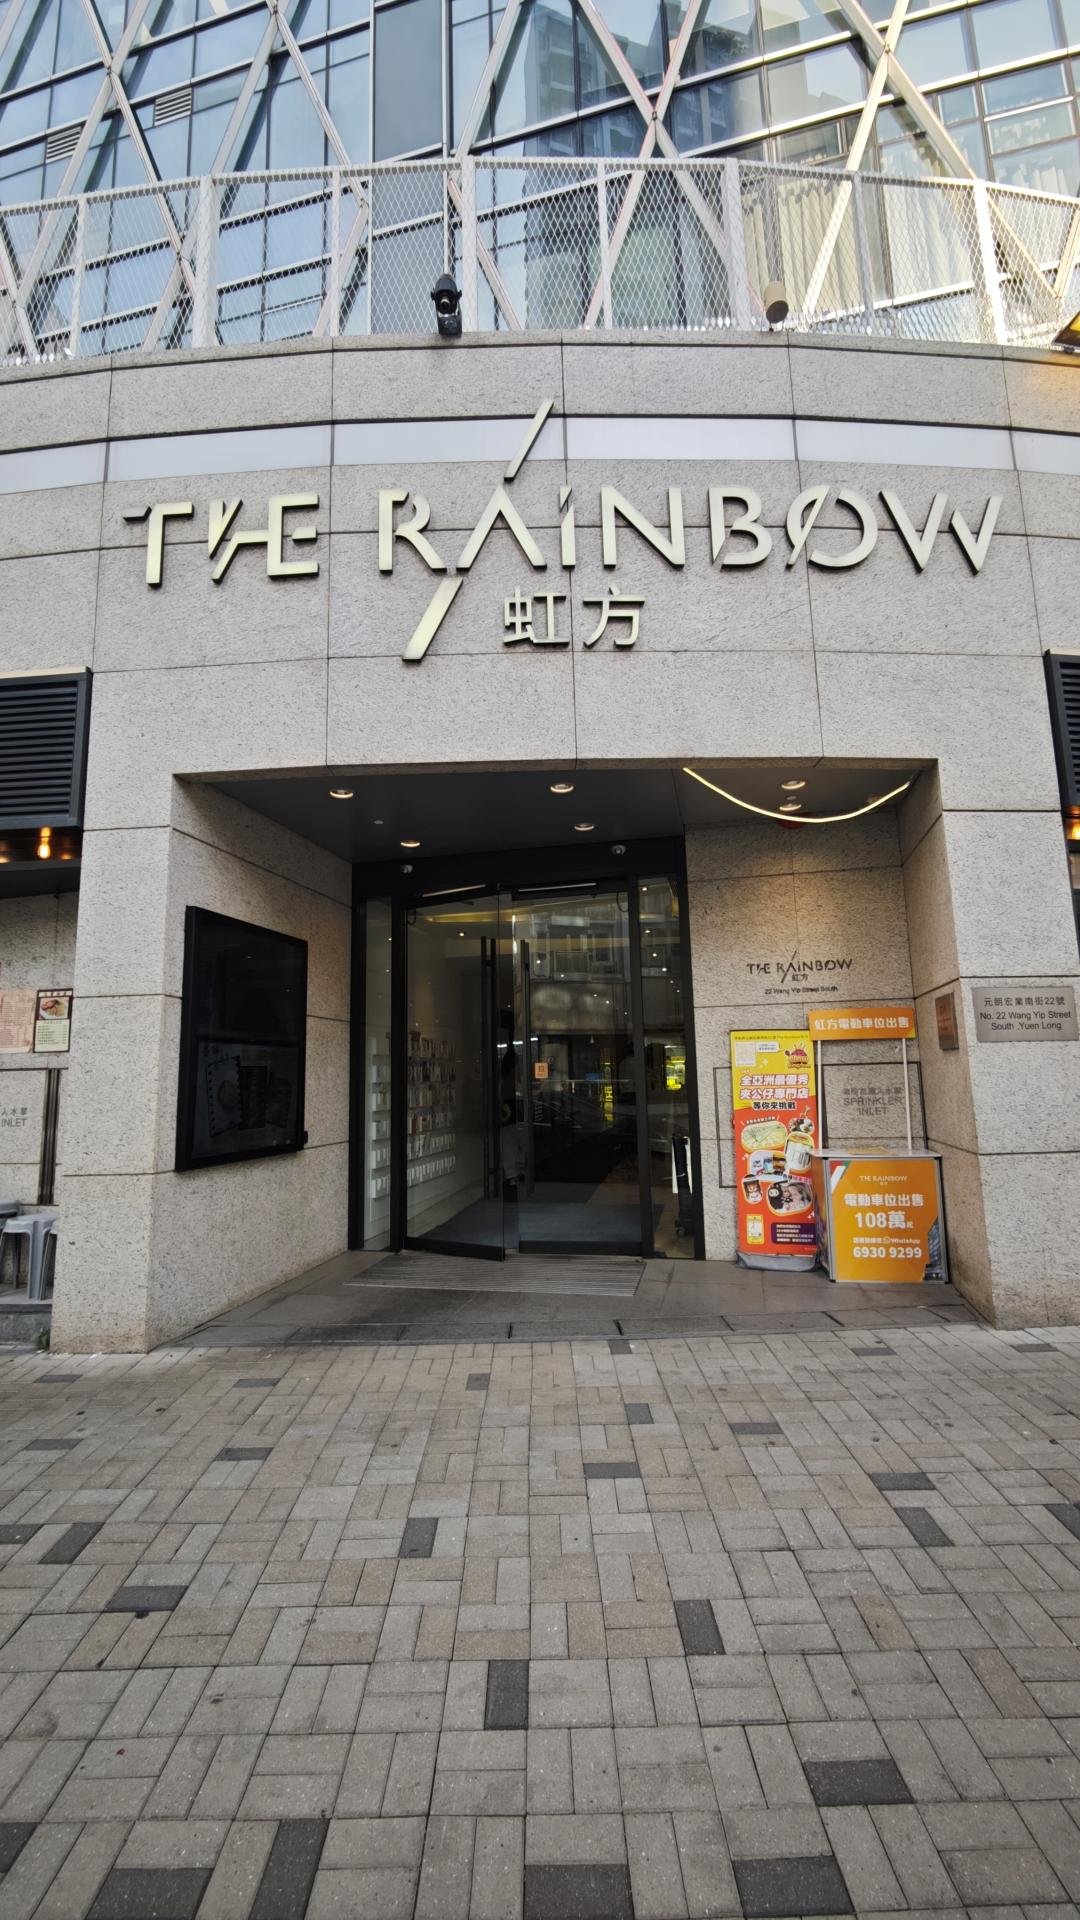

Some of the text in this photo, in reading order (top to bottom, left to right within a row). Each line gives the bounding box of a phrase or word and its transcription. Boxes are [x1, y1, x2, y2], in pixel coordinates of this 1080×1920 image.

[122, 493, 320, 588] THE
[502, 586, 646, 648] 虹方
[747, 962, 771, 975] THE
[980, 1010, 1071, 1020] No. 22 Wang Yip Street
[992, 1021, 1014, 1030] South
[1041, 1020, 1062, 1030] Long
[1, 1117, 26, 1128] INLET
[844, 1193, 924, 1207] 電動車位出售
[853, 1247, 922, 1258] 6930 9299
